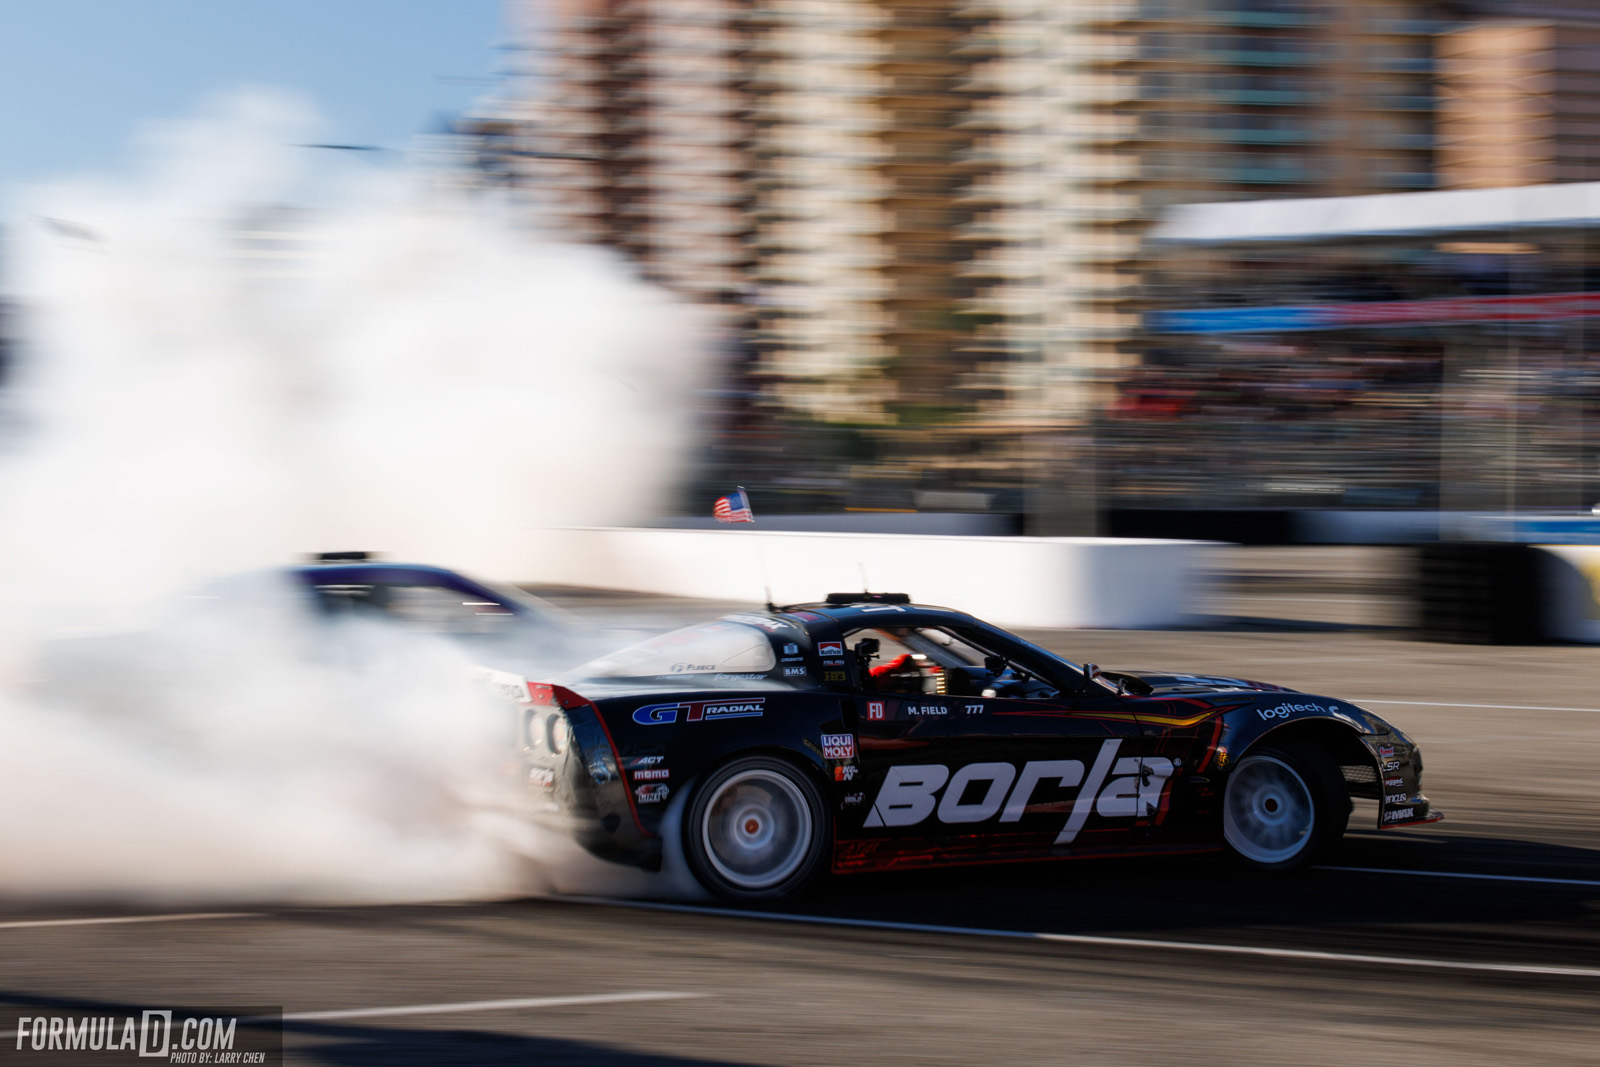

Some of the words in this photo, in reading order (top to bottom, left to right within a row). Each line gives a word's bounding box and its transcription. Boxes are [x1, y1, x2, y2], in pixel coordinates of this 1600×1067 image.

[785, 667, 805, 676] BMS
[706, 704, 764, 714] RADIAL
[869, 703, 883, 719] FD
[908, 706, 919, 715] M.
[921, 706, 948, 715] FIELD
[965, 704, 984, 714] 777
[1256, 702, 1326, 721] logitech
[823, 735, 851, 747] LIQUI
[824, 747, 852, 757] MOLY
